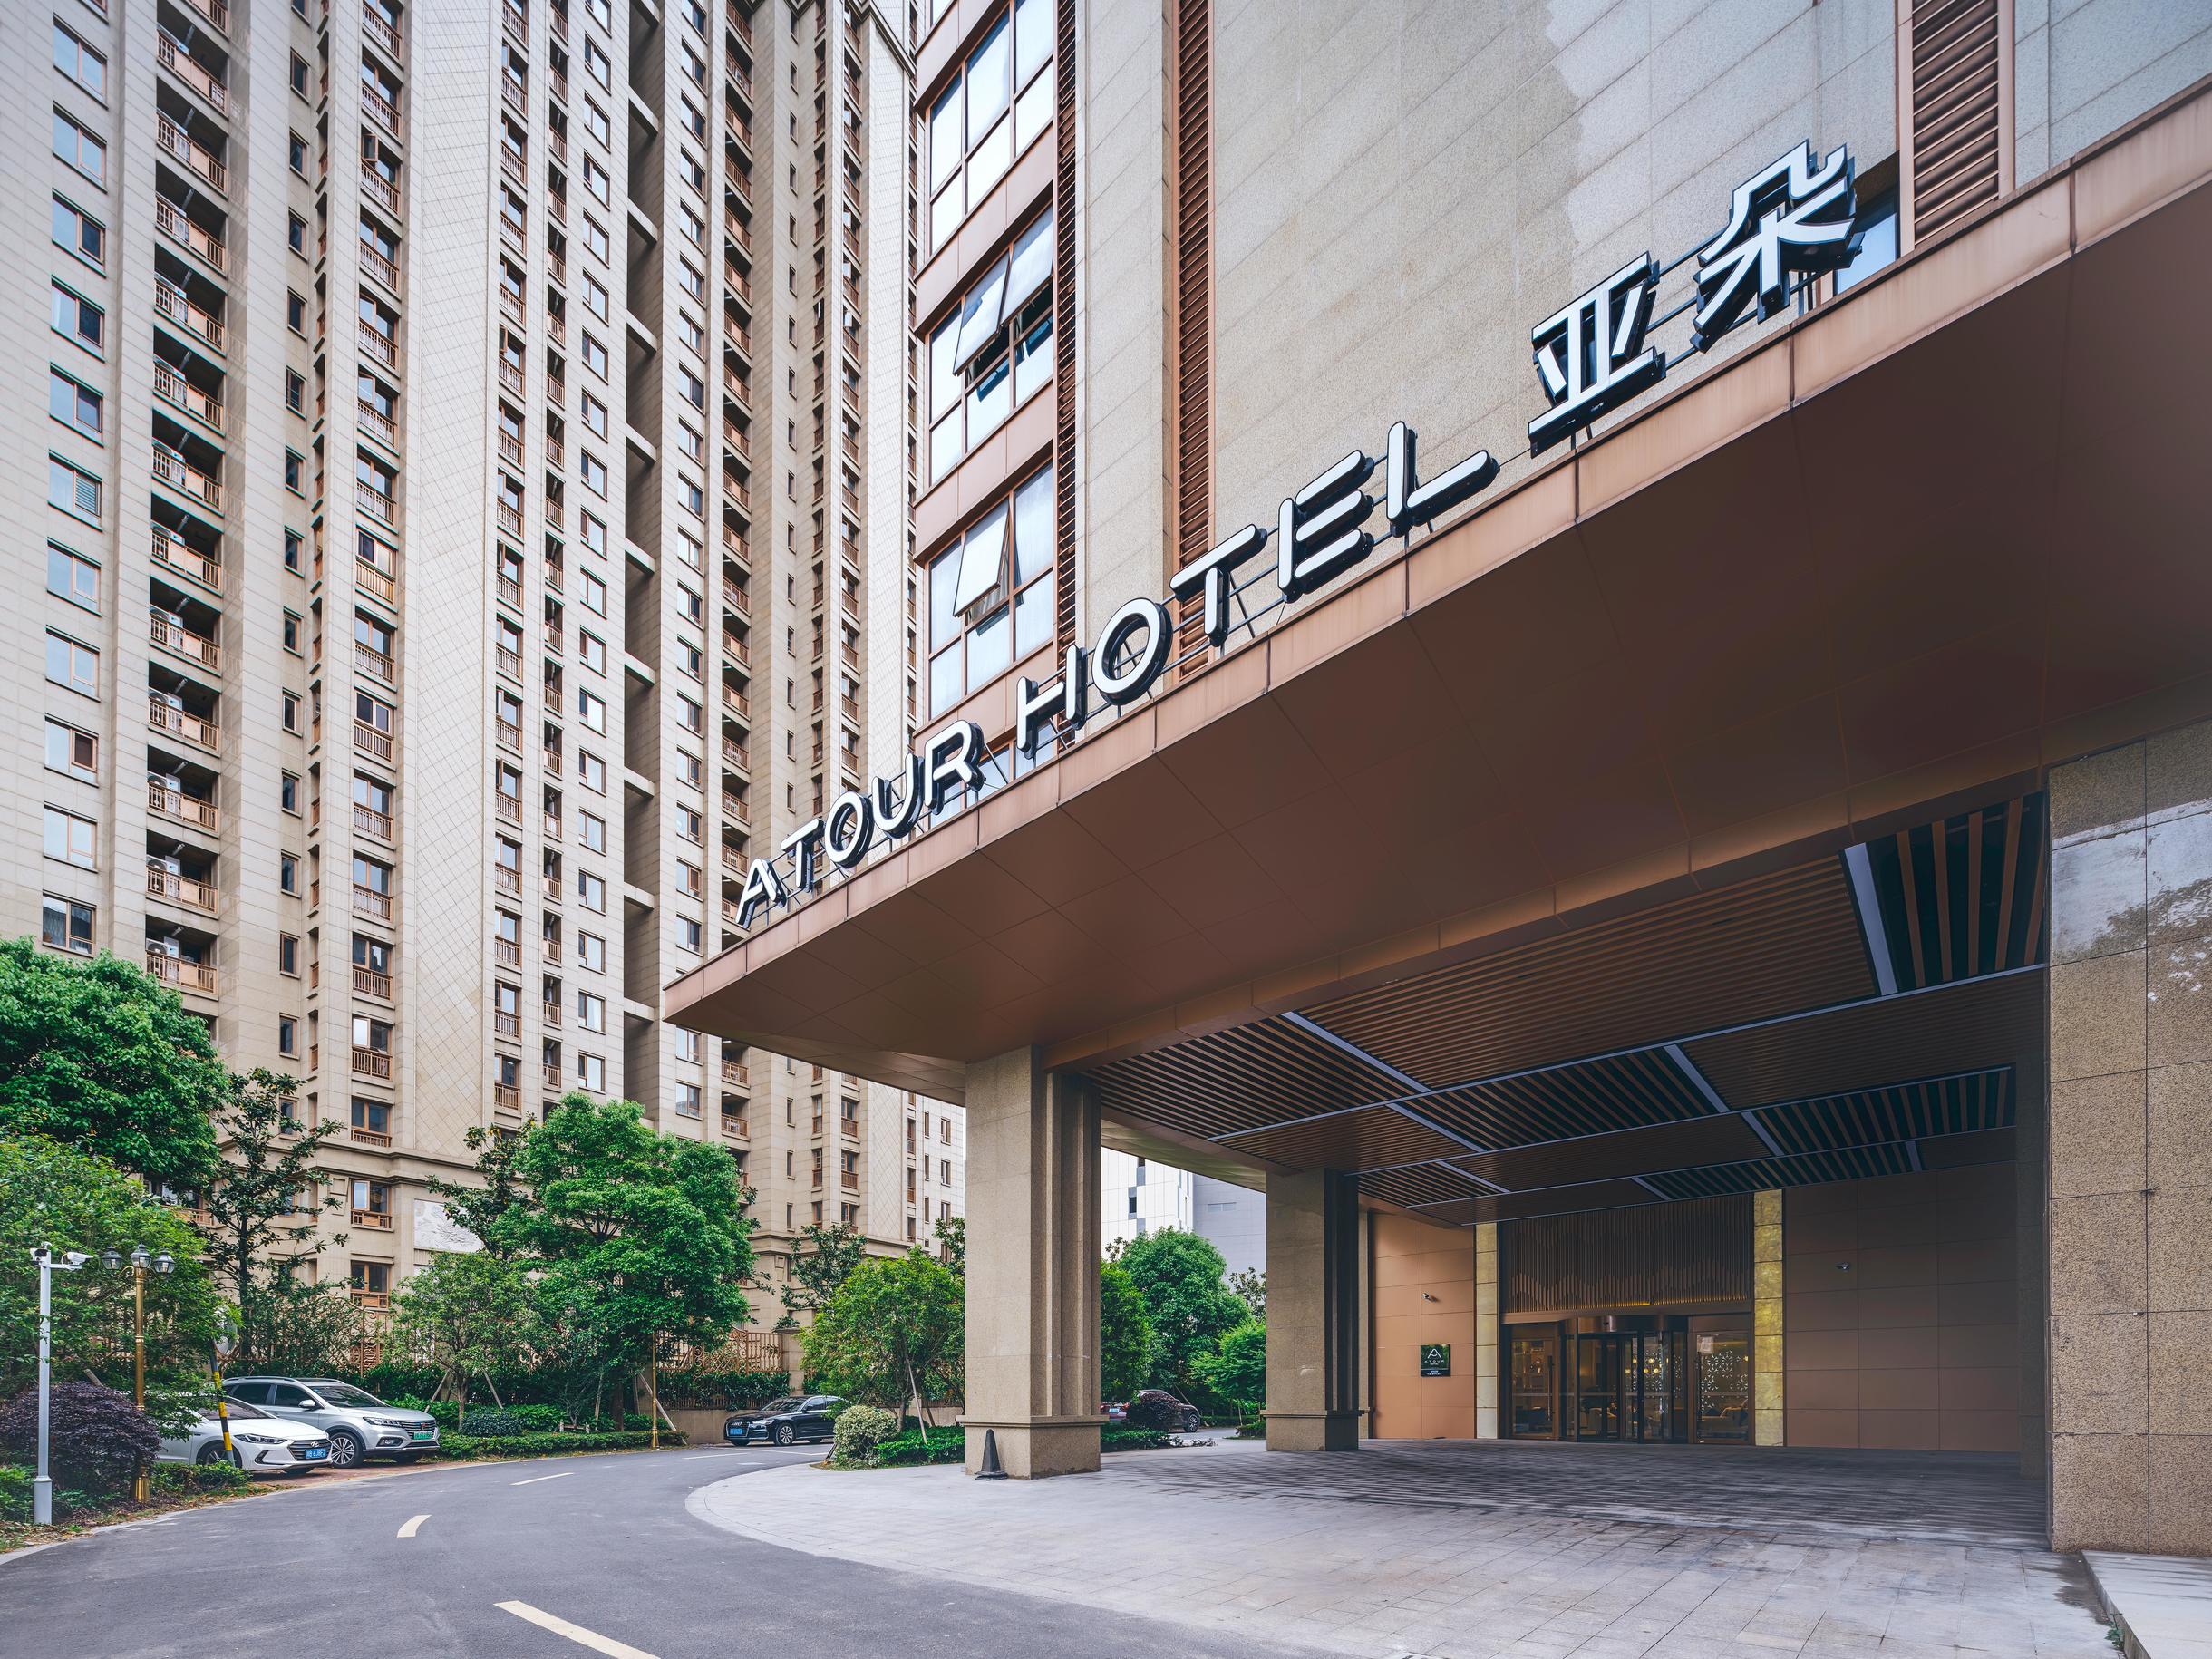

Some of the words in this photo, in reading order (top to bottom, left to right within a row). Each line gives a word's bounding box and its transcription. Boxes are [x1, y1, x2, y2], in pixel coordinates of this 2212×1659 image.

[735, 719, 986, 929] ATOUR
[1015, 420, 1500, 760] HOTEL
[1527, 139, 1864, 459] 亚朵
